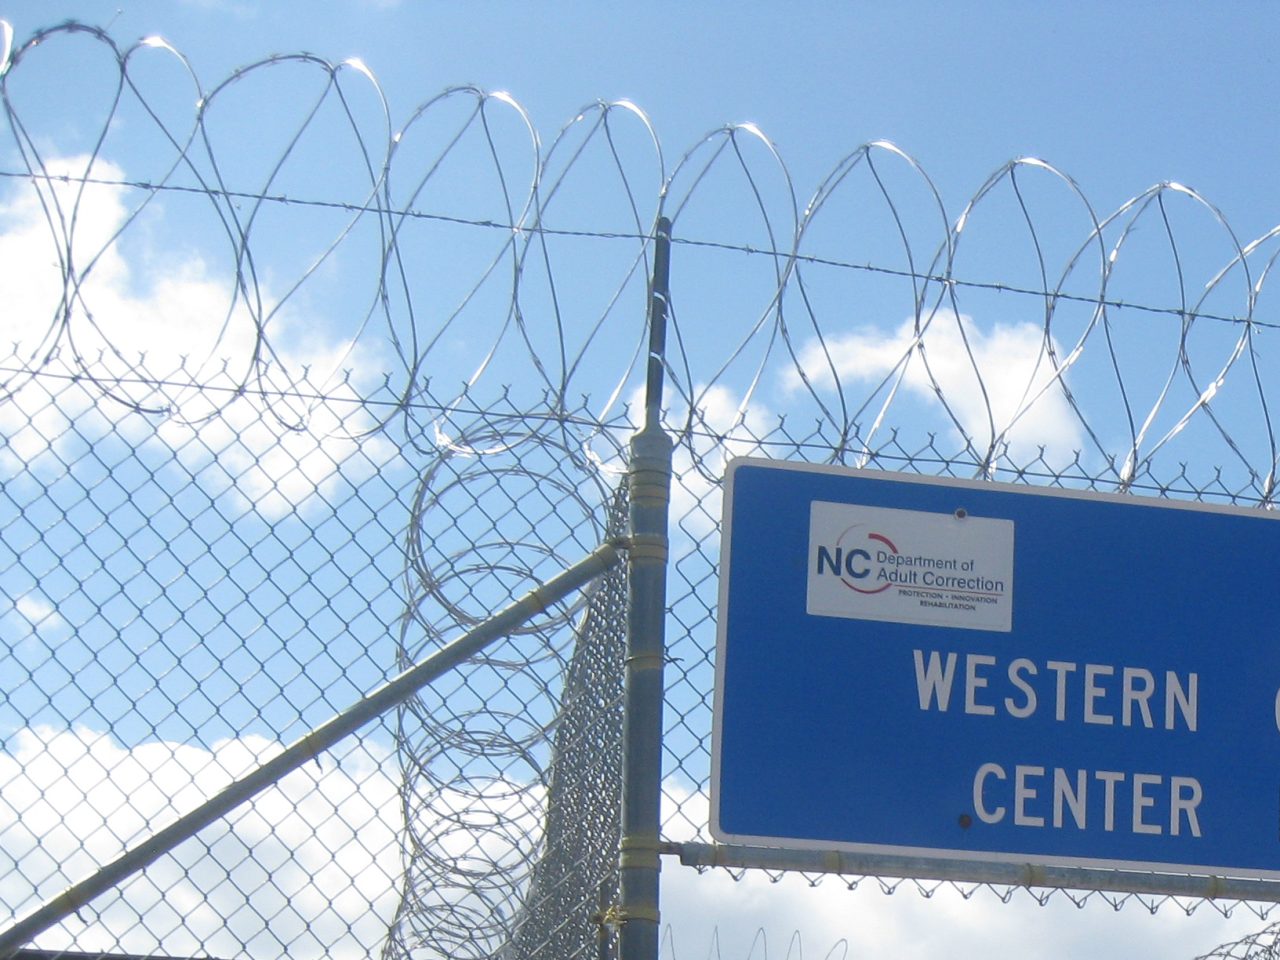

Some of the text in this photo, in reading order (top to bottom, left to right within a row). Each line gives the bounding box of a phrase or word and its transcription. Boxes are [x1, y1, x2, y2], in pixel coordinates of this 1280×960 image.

[817, 545, 871, 579] NC
[877, 551, 974, 571] Department of
[876, 568, 1004, 592] Adult Correction
[898, 589, 998, 605] PROTECTION INNOVATION
[920, 600, 976, 611] REHABILITATION
[913, 649, 1198, 732] WESTERN
[973, 763, 1203, 837] CENTER
